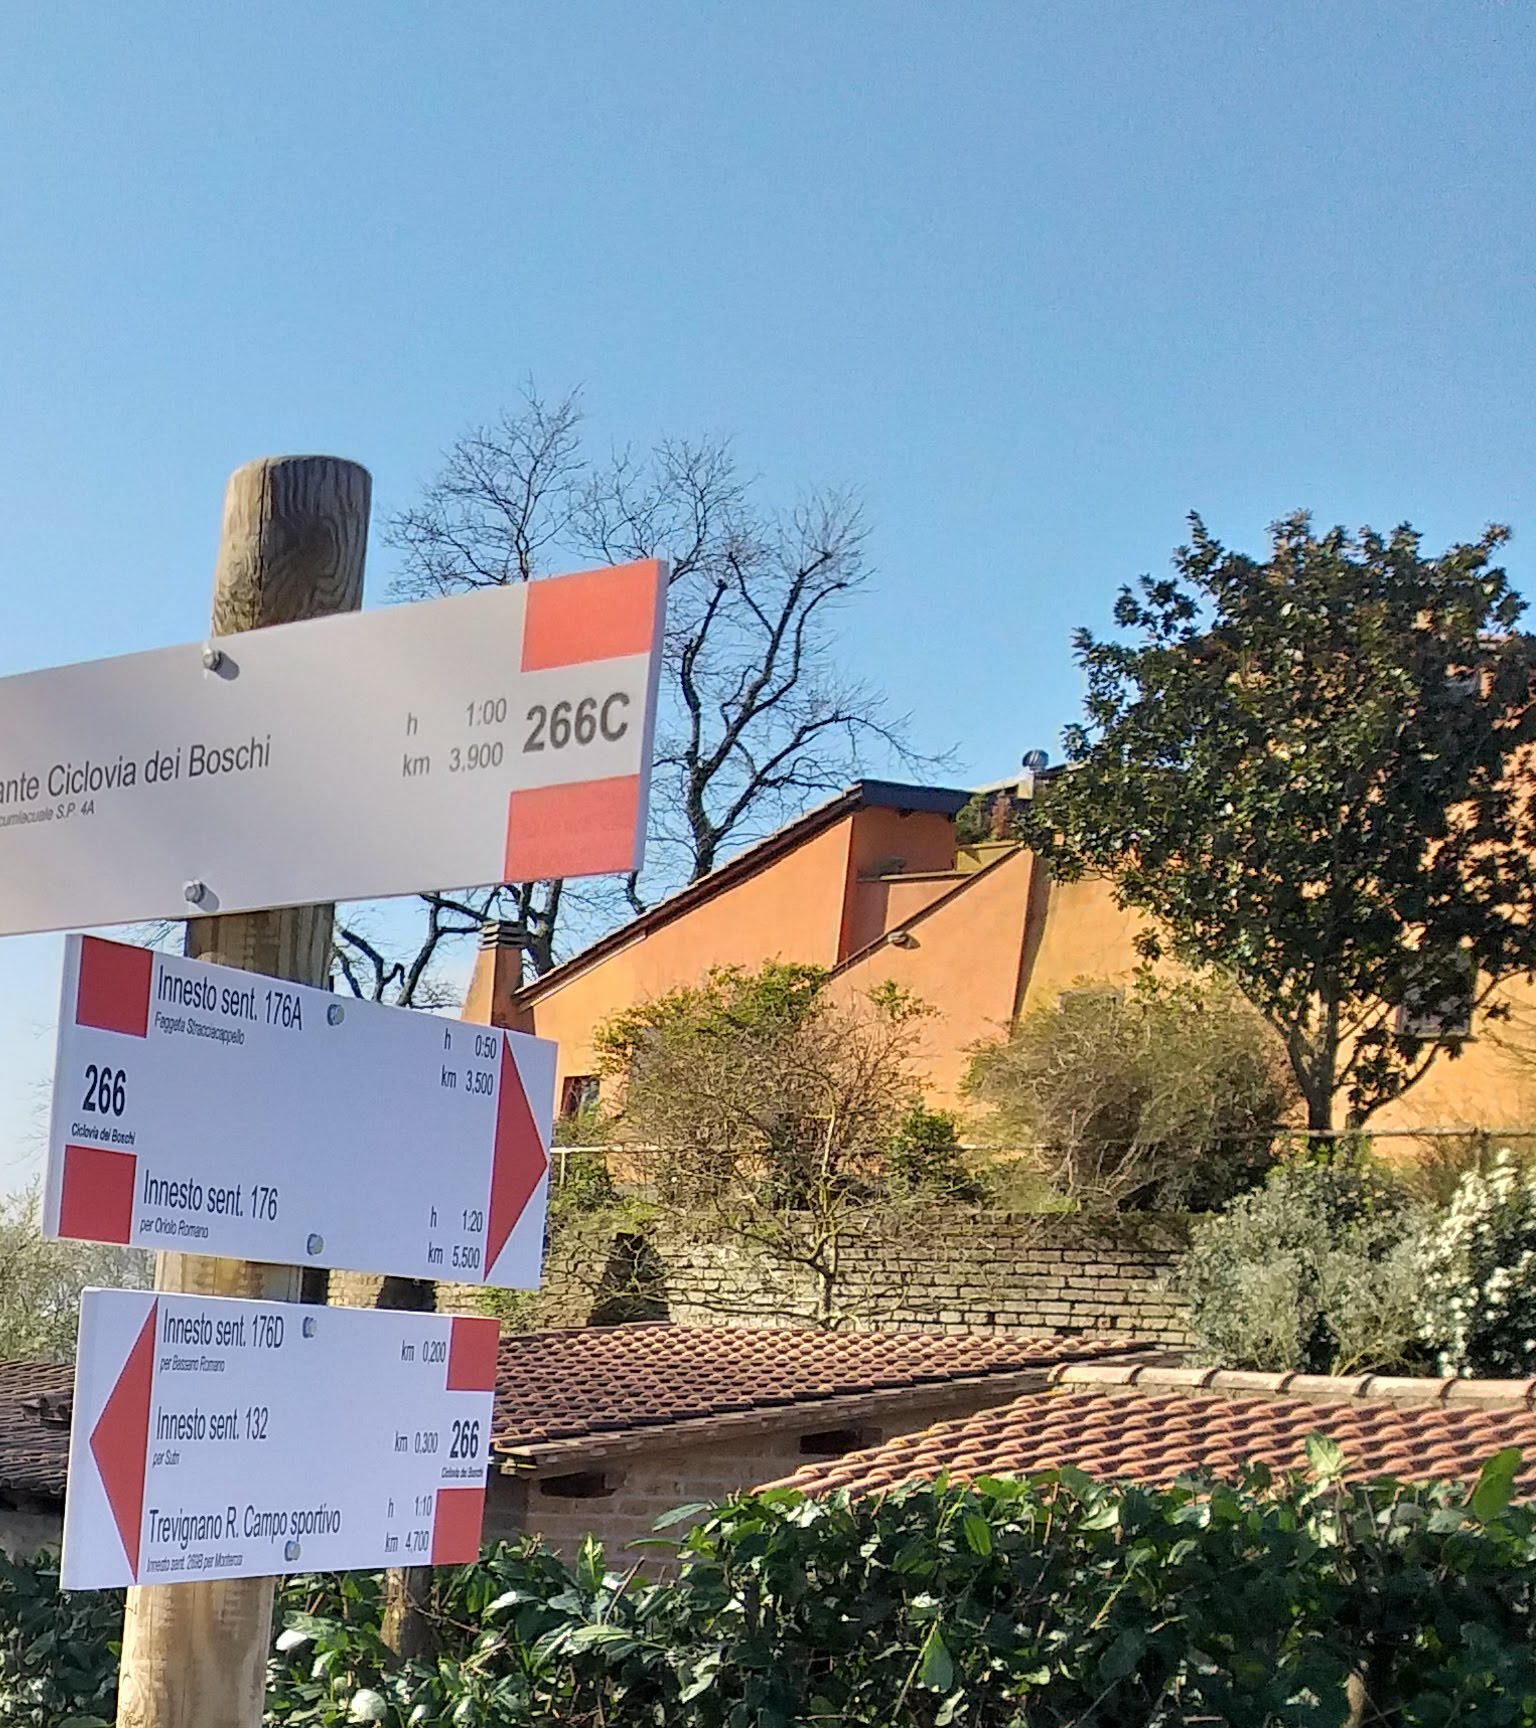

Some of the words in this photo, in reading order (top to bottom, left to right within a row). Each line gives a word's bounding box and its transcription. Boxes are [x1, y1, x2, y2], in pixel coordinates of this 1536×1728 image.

[407, 712, 418, 736] h
[466, 698, 507, 727] 1:00
[522, 692, 630, 754] 266C
[47, 755, 136, 797] Ciclovia
[144, 747, 180, 783] dei
[189, 734, 271, 778] Boschi
[403, 754, 430, 777] km
[80, 800, 95, 815] 4A
[157, 965, 217, 1011] Innesto
[221, 987, 258, 1021] sent.
[265, 990, 303, 1031] 176A
[154, 1011, 186, 1034] Faggeta
[444, 1027, 452, 1050] h
[475, 1034, 497, 1059] 0:50
[82, 1064, 126, 1117] 266
[441, 1064, 457, 1088] km
[465, 1070, 494, 1096] 3,500
[71, 1123, 99, 1140] Ciclovia
[100, 1127, 111, 1142] dei
[112, 1129, 136, 1146] Boschi
[143, 1169, 202, 1211] Innesto
[207, 1184, 244, 1217] sent.
[251, 1184, 278, 1221] 176
[139, 1219, 154, 1234] per
[178, 1219, 209, 1239] Romano
[430, 1205, 437, 1228] h
[462, 1209, 483, 1233] 1:20
[428, 1241, 443, 1265] km
[452, 1245, 480, 1269] 5,500
[163, 1308, 213, 1345] Innesto
[215, 1314, 246, 1347] sent.
[252, 1314, 284, 1349] 176D
[401, 1339, 414, 1361] km
[422, 1340, 446, 1364] 0,200
[156, 1406, 206, 1440] Innesto
[209, 1408, 239, 1440] sent.
[245, 1406, 269, 1440] 132
[449, 1419, 480, 1459] 266
[394, 1430, 408, 1452] km
[414, 1432, 438, 1454] 0,300
[387, 1497, 394, 1518] h
[415, 1495, 432, 1517] 1:10
[149, 1508, 222, 1550] Trevignano
[226, 1506, 239, 1539] R.
[243, 1505, 287, 1544] Campo
[290, 1503, 341, 1543] sportivo
[385, 1531, 398, 1552] km
